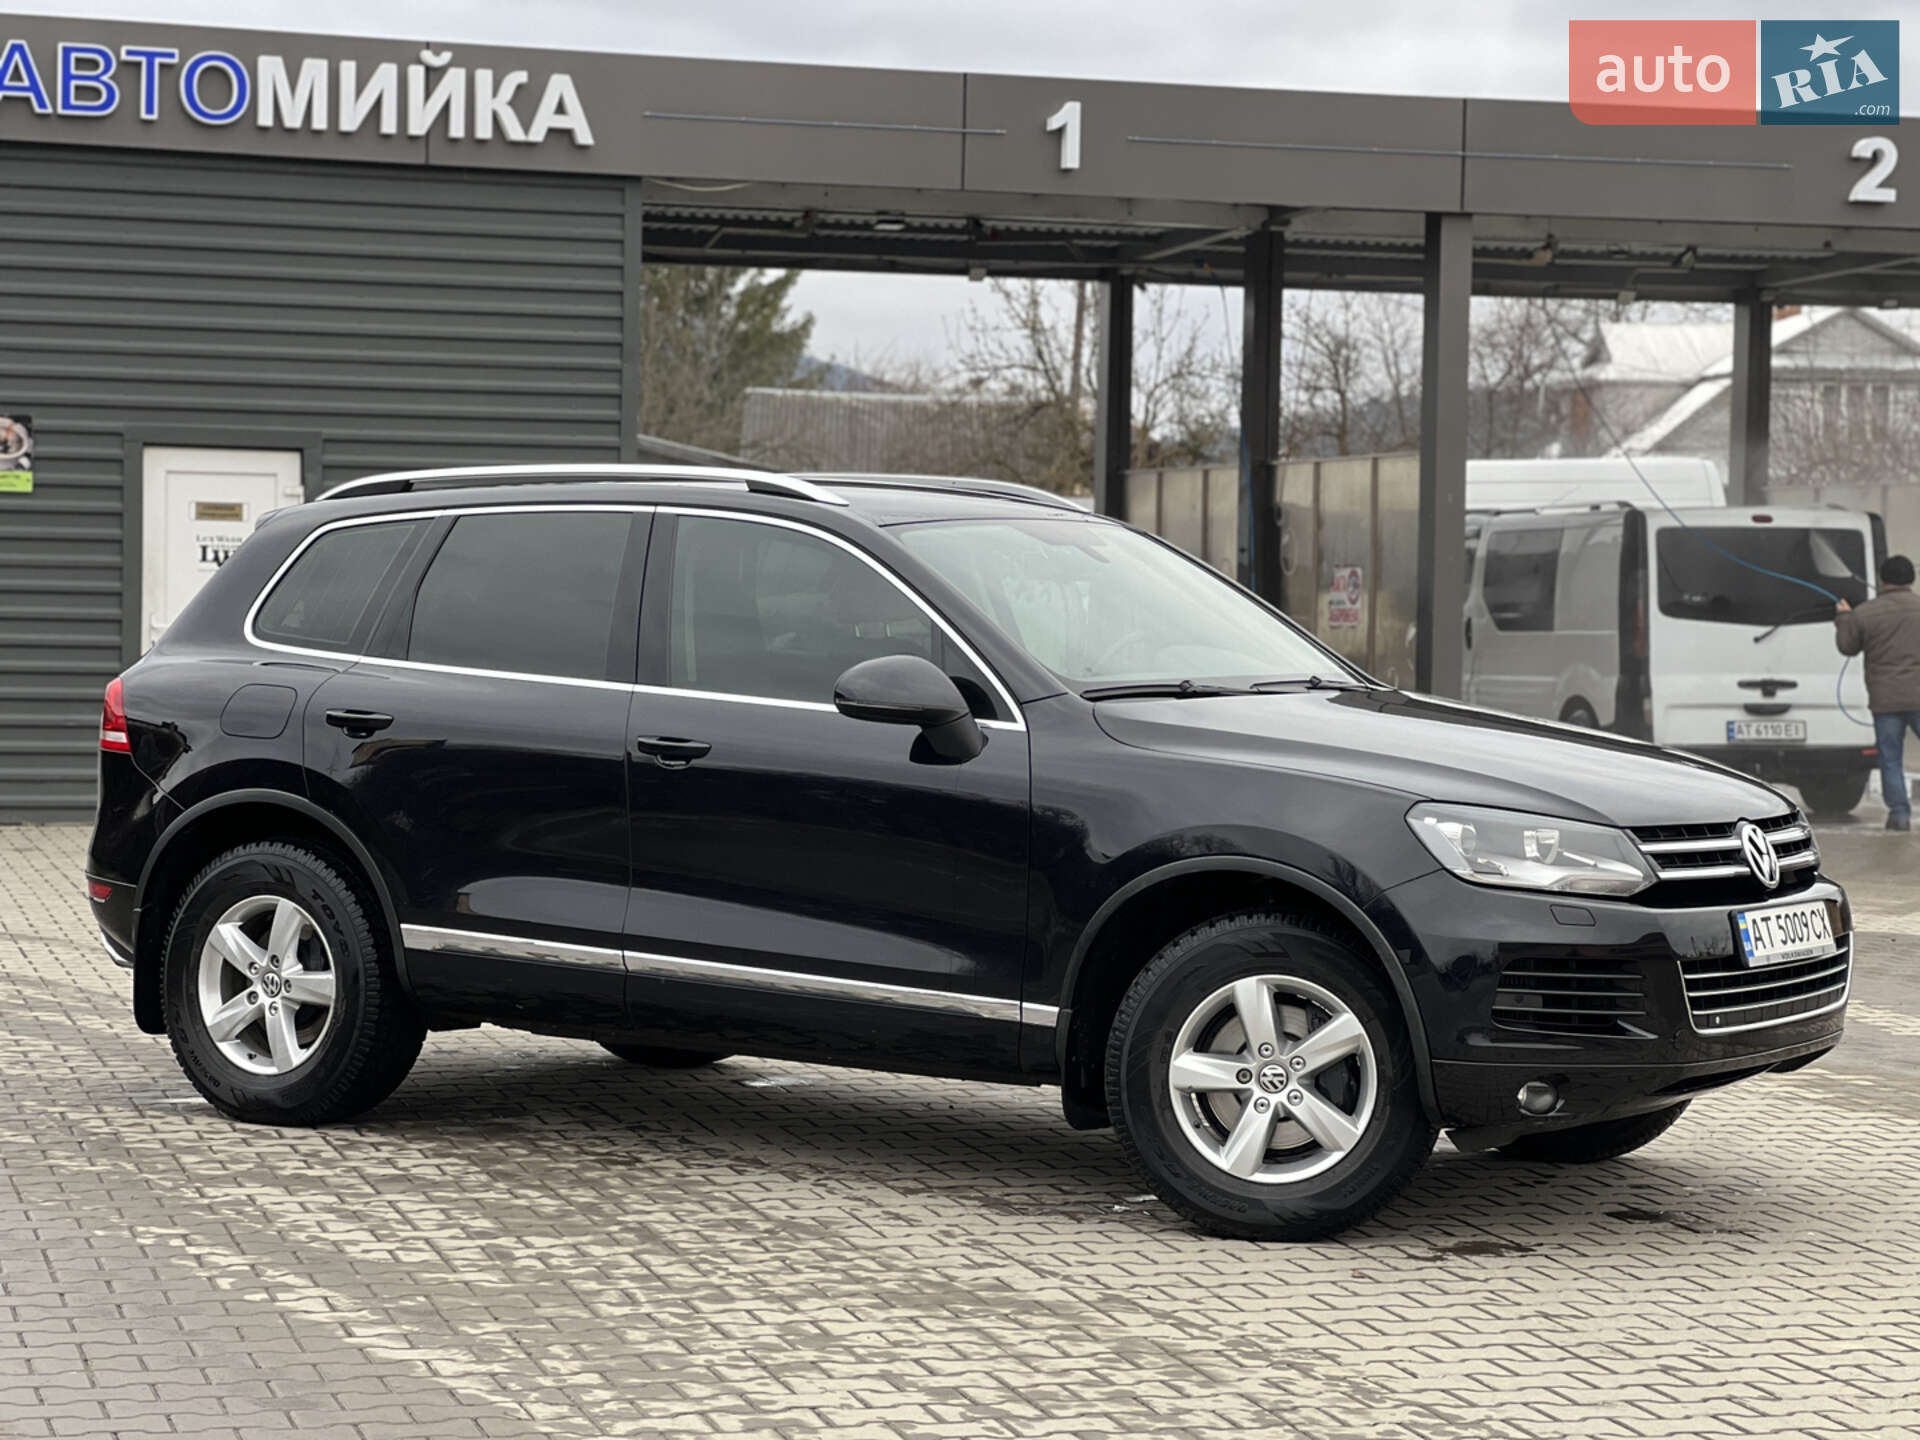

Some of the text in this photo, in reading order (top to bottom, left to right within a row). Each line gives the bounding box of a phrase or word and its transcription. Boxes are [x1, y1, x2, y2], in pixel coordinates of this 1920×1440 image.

[0, 39, 595, 147] АВТОМИЙКА
[1046, 101, 1081, 169] 1
[1848, 136, 1899, 203] 2
[1736, 723, 1752, 737] AT
[1755, 724, 1783, 737] 6110
[1751, 908, 1832, 951] AT 5009 CX
